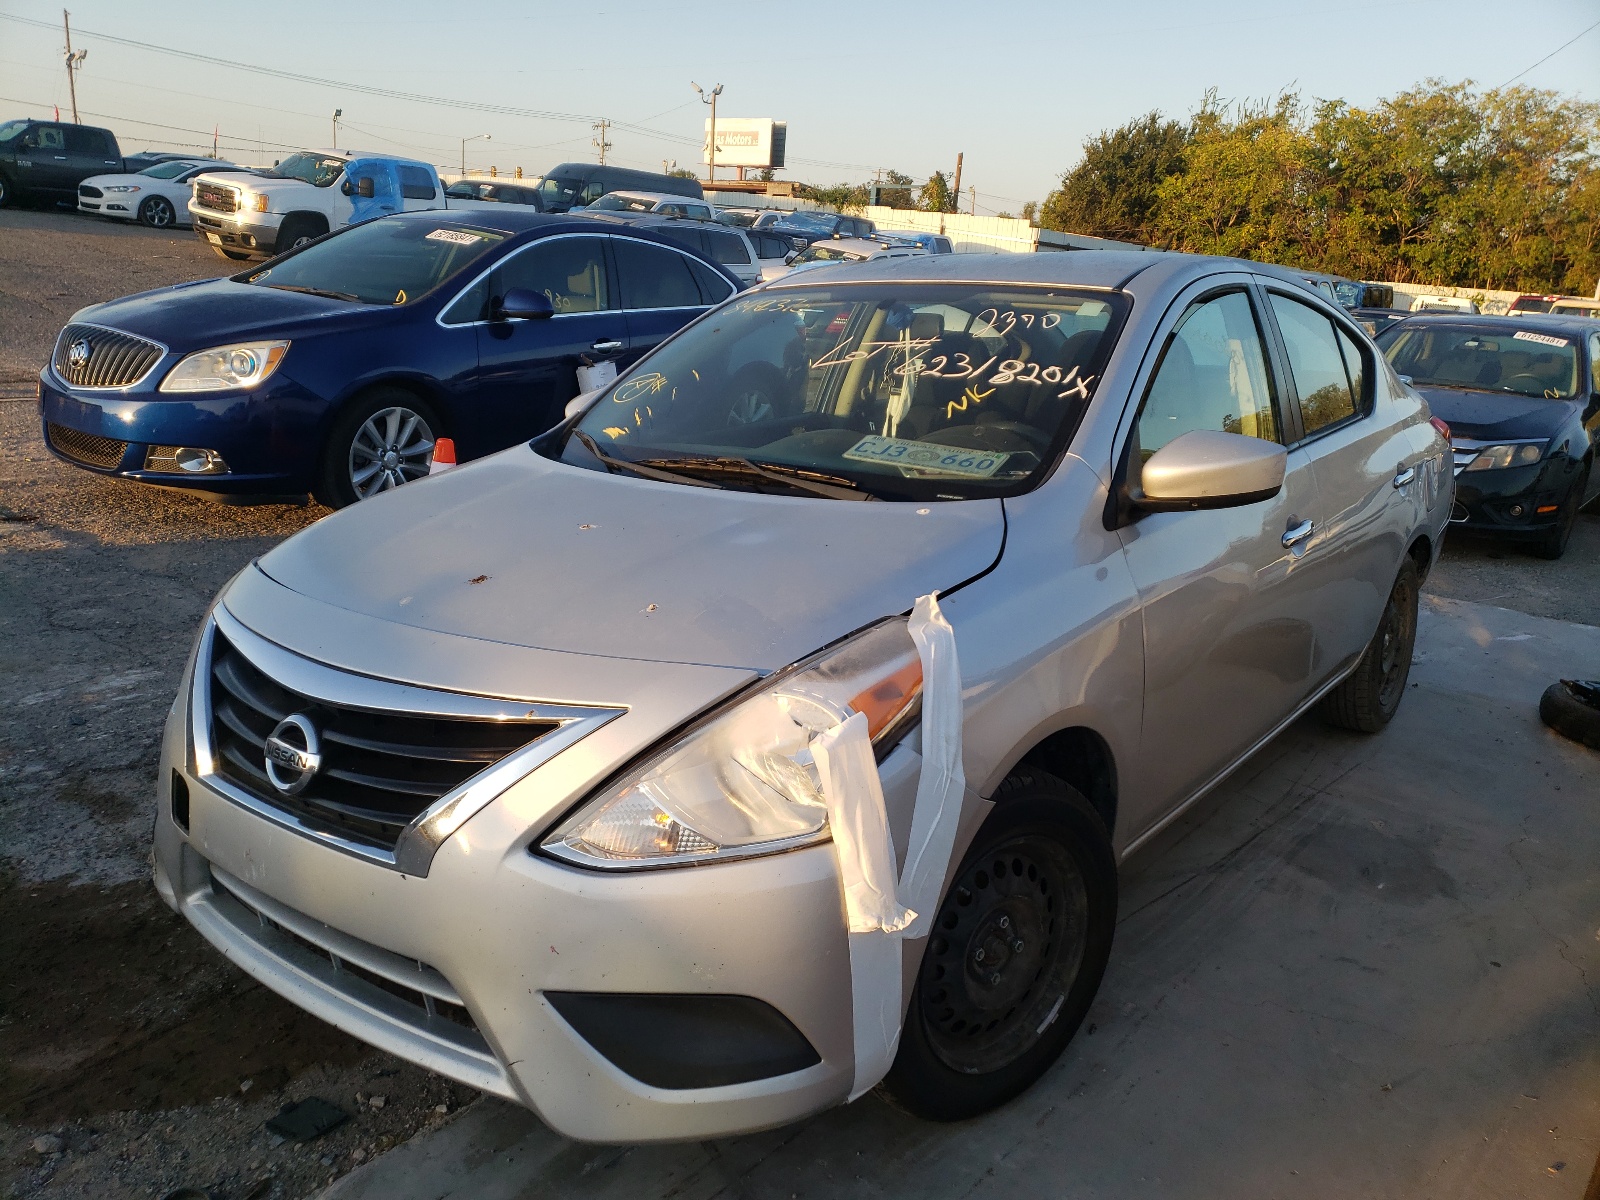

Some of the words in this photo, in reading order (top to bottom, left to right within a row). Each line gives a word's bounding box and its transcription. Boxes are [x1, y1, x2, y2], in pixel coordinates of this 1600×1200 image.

[706, 132, 725, 145] Alas
[725, 132, 752, 145] Motors
[204, 192, 222, 203] GMC
[972, 308, 1061, 338] 2370
[853, 441, 908, 457] CJ3
[940, 454, 995, 471] 660
[266, 742, 309, 769] NISSAN
